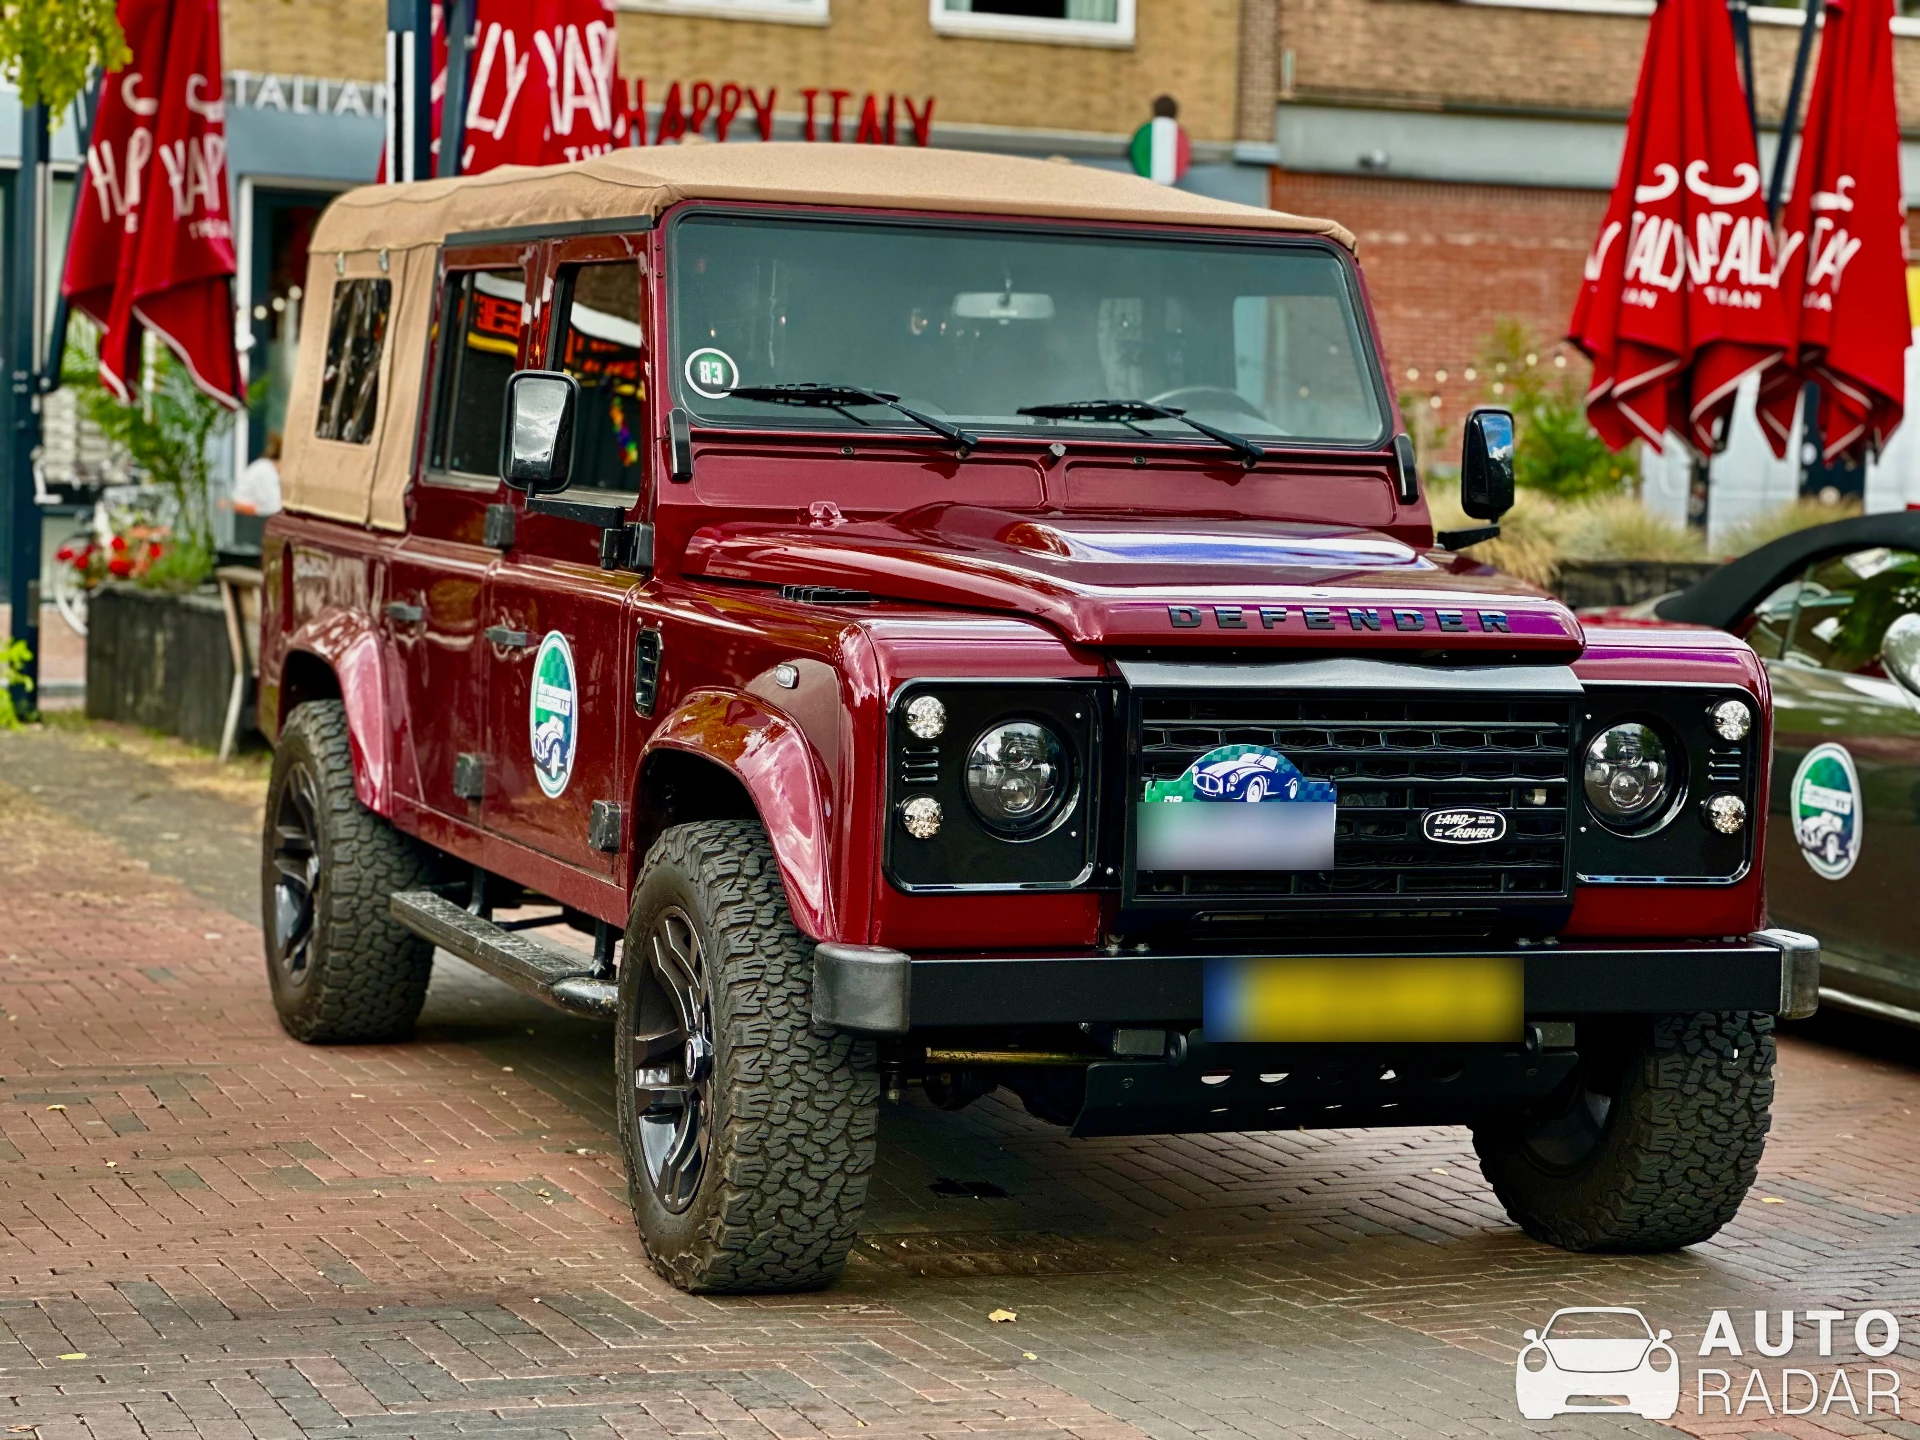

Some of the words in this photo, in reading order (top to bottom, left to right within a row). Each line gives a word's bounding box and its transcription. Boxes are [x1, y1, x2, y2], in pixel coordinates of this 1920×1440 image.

[613, 78, 777, 148] HAPPY
[700, 361, 723, 385] 83
[1167, 605, 1512, 633] DEFENDER
[1434, 814, 1470, 825] LAND
[1453, 827, 1496, 839] ROVER
